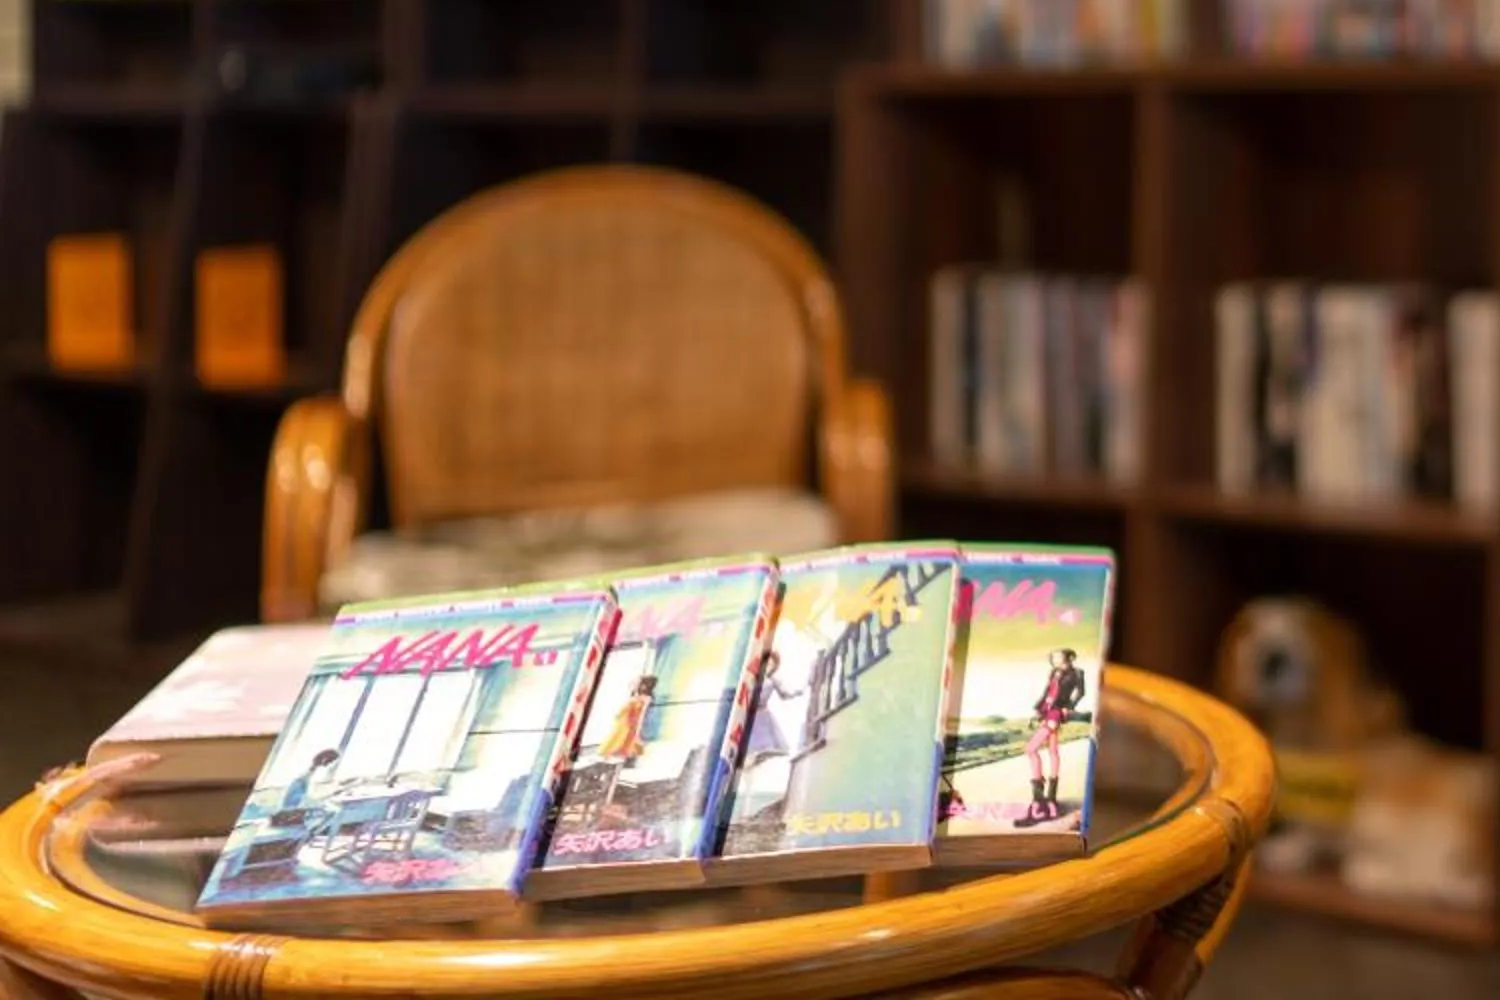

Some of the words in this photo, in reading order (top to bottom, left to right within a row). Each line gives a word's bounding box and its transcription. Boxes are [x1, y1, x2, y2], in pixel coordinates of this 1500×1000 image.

[341, 623, 540, 680] NANA
[553, 825, 673, 856] 矢沢あい
